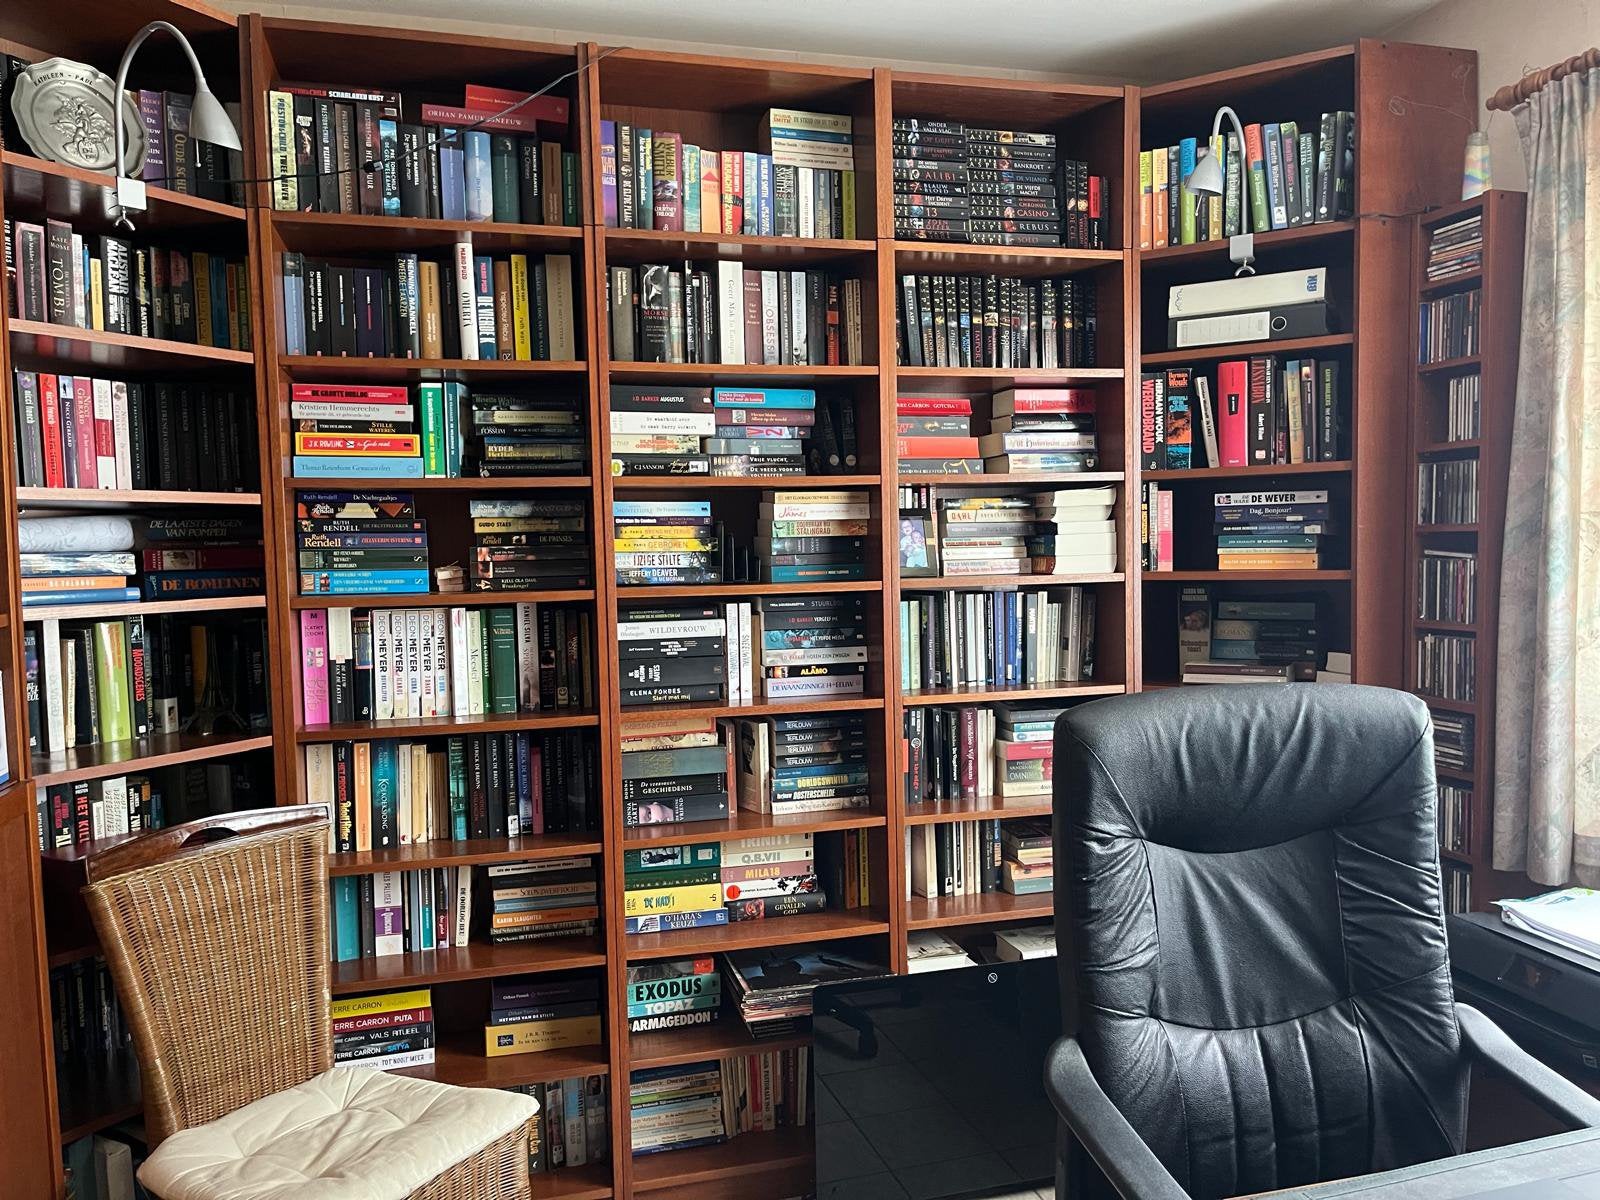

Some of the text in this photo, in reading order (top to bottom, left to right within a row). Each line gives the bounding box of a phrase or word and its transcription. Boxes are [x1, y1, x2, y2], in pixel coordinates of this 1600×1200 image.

[428, 110, 455, 118] ORHAN
[654, 142, 665, 176] SMITH
[666, 142, 675, 176] WILBUR
[926, 208, 938, 216] 13
[107, 239, 120, 294] MACLEAN
[117, 244, 129, 294] ALISTAIR
[52, 258, 65, 318] TOMBE
[407, 259, 416, 335] HENNING MANKELL
[1142, 380, 1154, 453] WERELDBRAND
[1155, 379, 1163, 443] HERMAN WOUK
[1251, 494, 1296, 503] DE WEVER
[797, 527, 831, 535] STALINGRAD
[304, 537, 341, 547] Rendell
[658, 555, 681, 565] STILTE
[163, 579, 182, 591] DE
[649, 625, 707, 634] WILDEVROUW
[378, 615, 388, 673] DEON MEYER
[394, 615, 404, 673] DEON MEYER
[408, 615, 418, 672] DEON MEYER
[422, 615, 432, 672] DEON MEYER
[438, 637, 446, 670] MEYER
[643, 785, 693, 794] GESCHIEDENIS
[741, 835, 792, 848] TRINITY
[775, 902, 806, 911] GEVALLEN
[664, 912, 702, 922] O'HARA'S
[671, 921, 697, 929] KEUZE
[635, 977, 702, 1001] EXODUS
[353, 1002, 382, 1010] CARRON
[645, 998, 695, 1014] TOPAZ
[356, 1014, 412, 1027] CARRON PUTA
[632, 1011, 711, 1032] ARMAGEDDON
[370, 1031, 389, 1039] VALS
[392, 1028, 419, 1037] RITUEEL
[354, 1048, 380, 1056] CARRON
